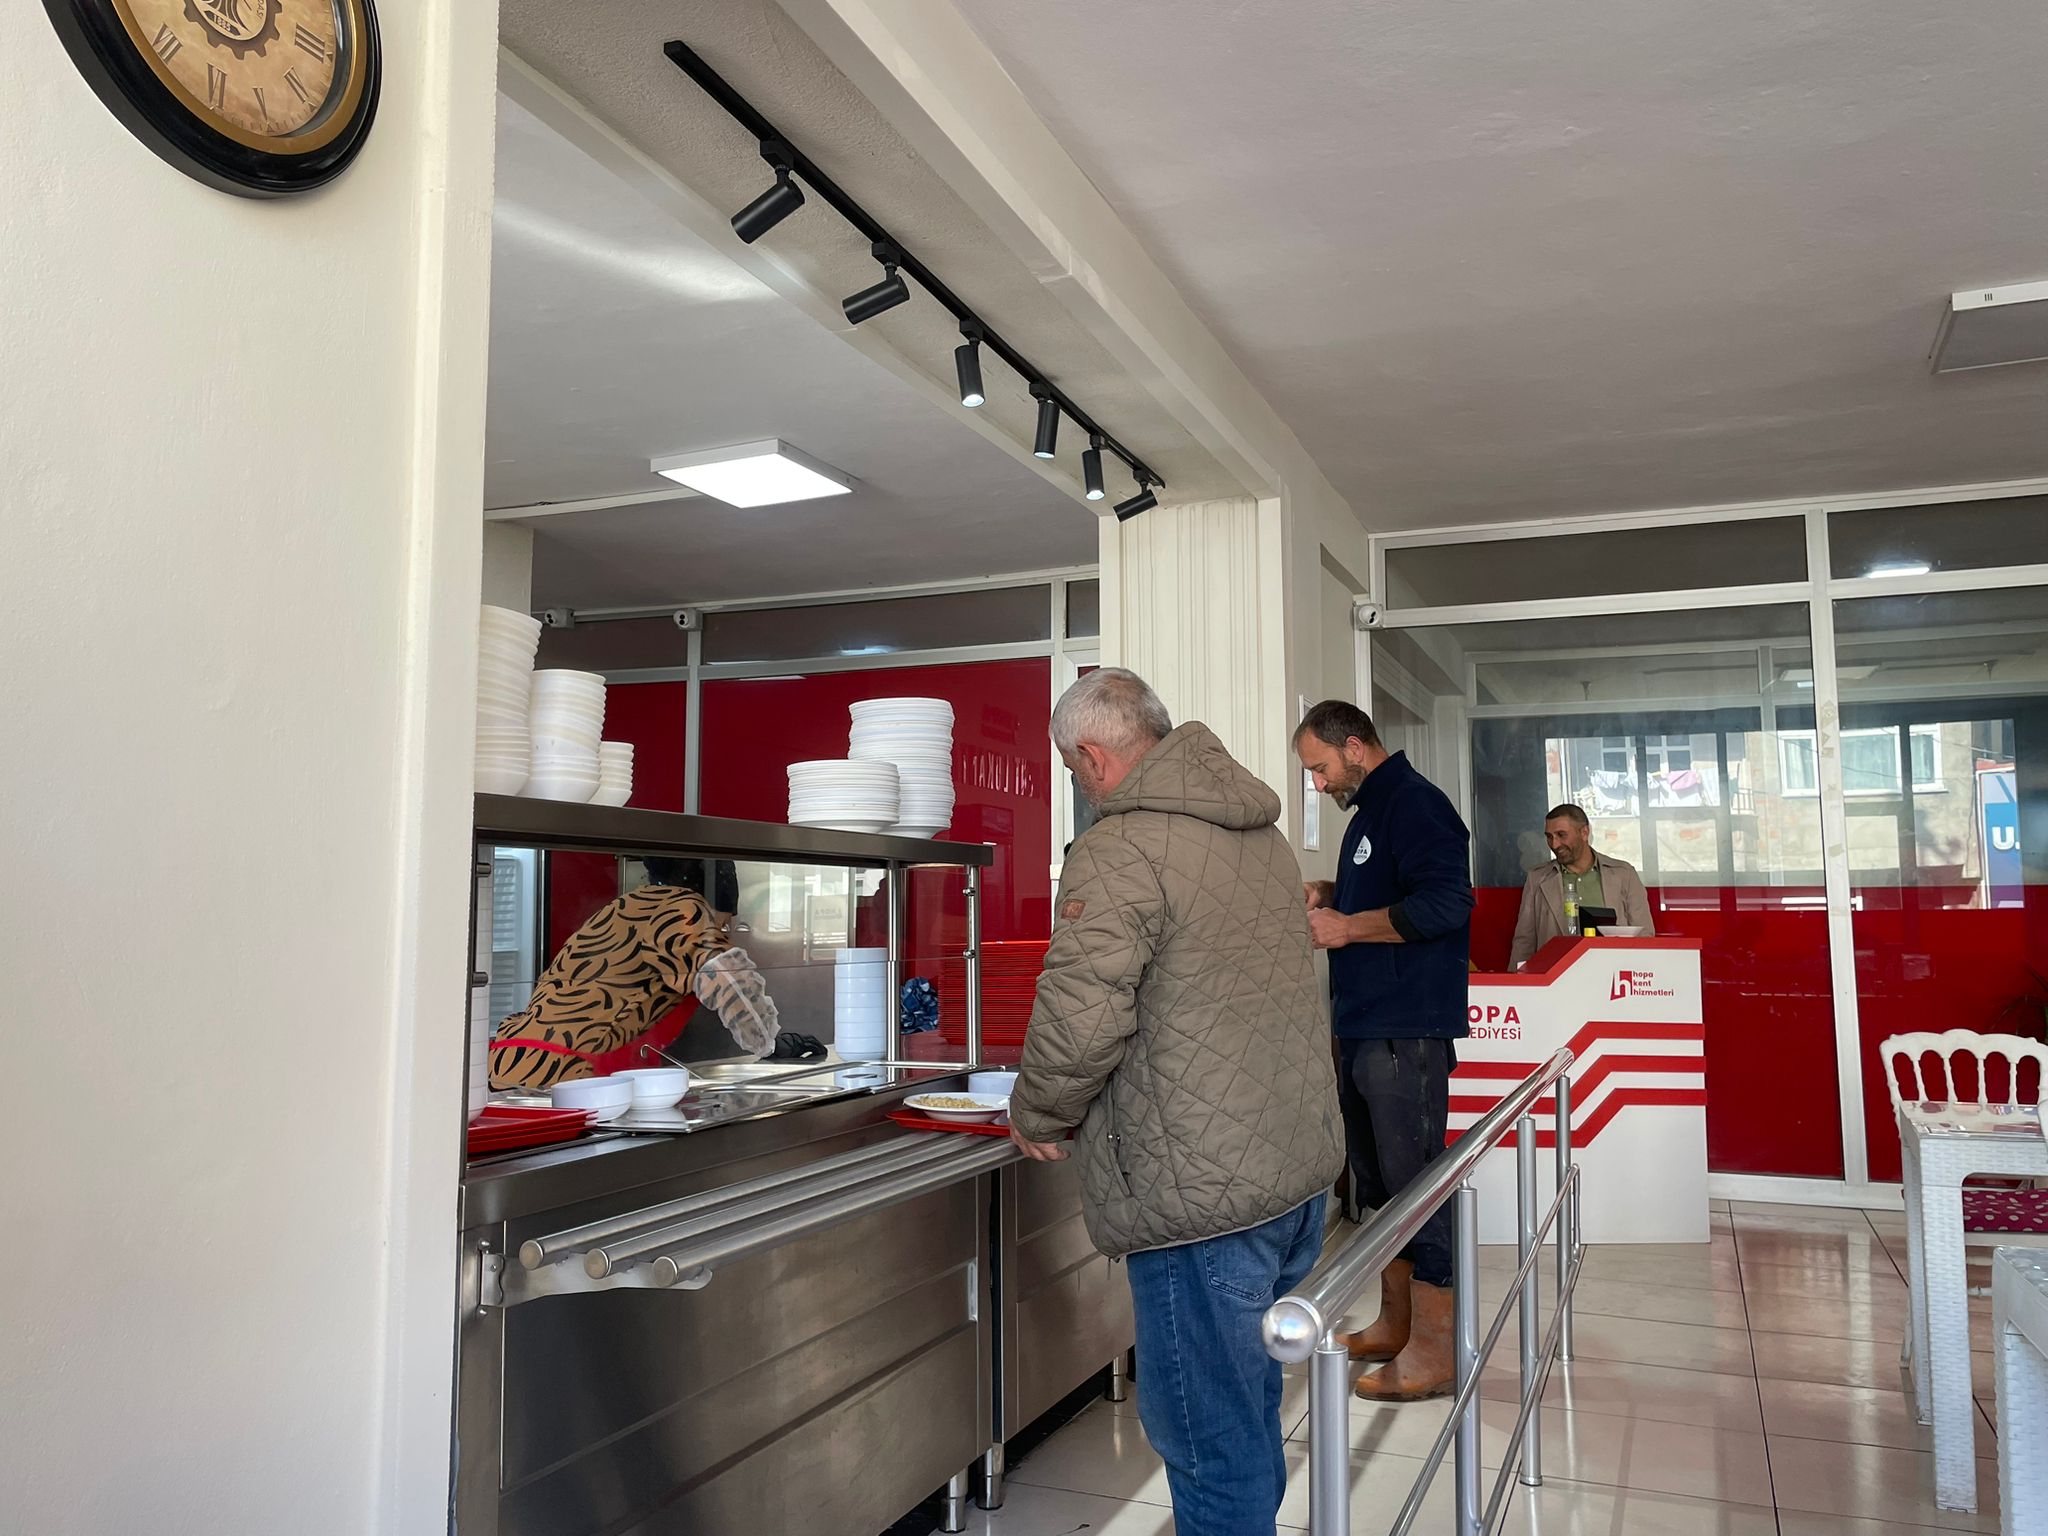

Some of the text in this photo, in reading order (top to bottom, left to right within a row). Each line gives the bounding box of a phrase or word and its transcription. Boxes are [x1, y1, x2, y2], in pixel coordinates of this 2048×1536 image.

[152, 22, 183, 65] VII
[294, 22, 326, 64] III
[207, 62, 227, 110] VI
[252, 86, 270, 122] V
[1633, 971, 1654, 979] hopa
[1633, 988, 1674, 996] hizmetleri
[1468, 1005, 1521, 1024] OPA
[1470, 1026, 1521, 1040] EDİYESİ
